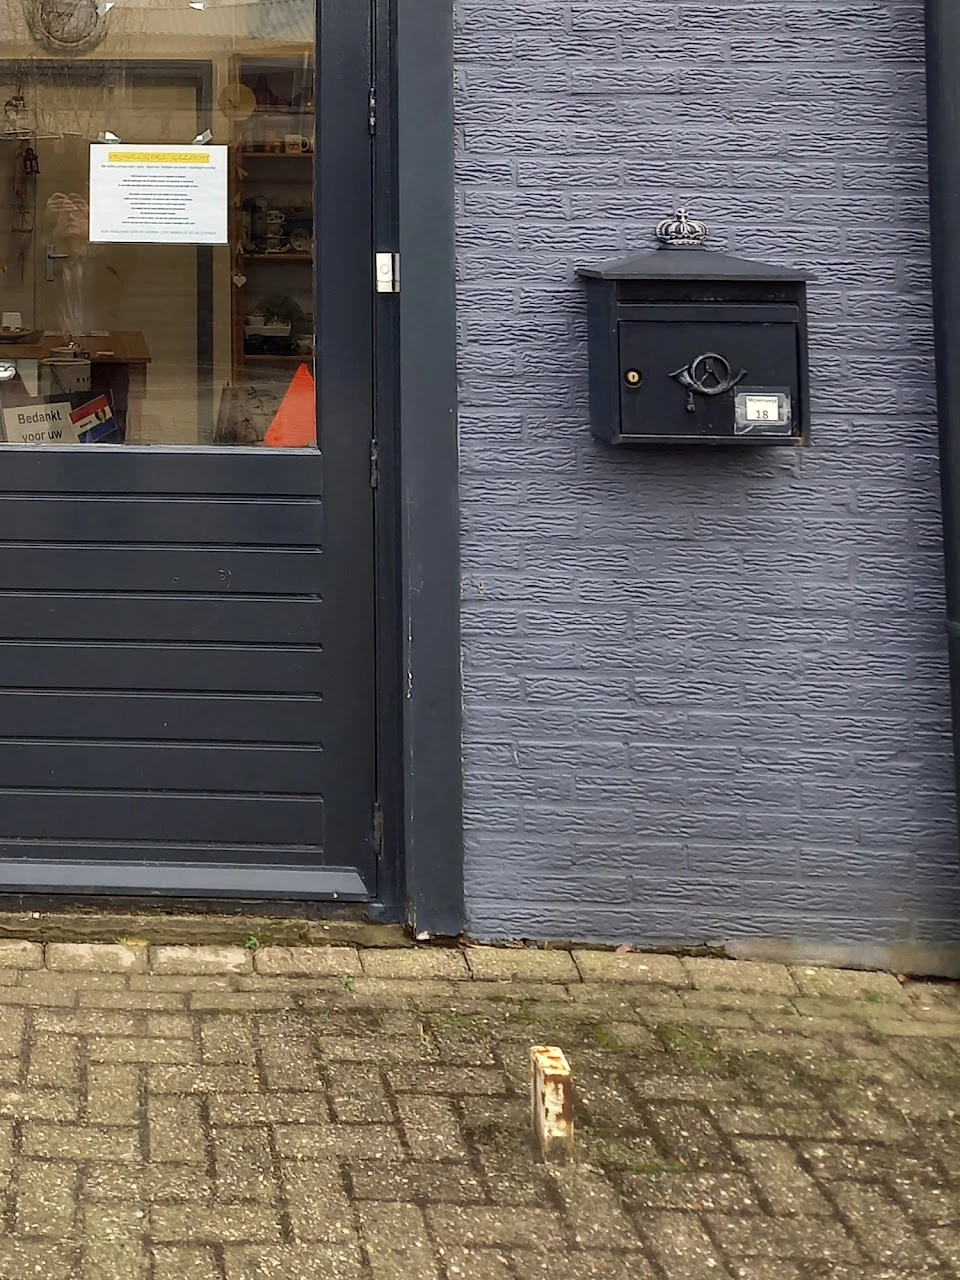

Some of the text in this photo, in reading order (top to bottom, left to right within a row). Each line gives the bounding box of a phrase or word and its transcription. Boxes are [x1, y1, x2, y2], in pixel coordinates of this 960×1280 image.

[17, 409, 62, 425] Bedankt
[756, 409, 769, 419] 18
[22, 429, 63, 443] voor uw
